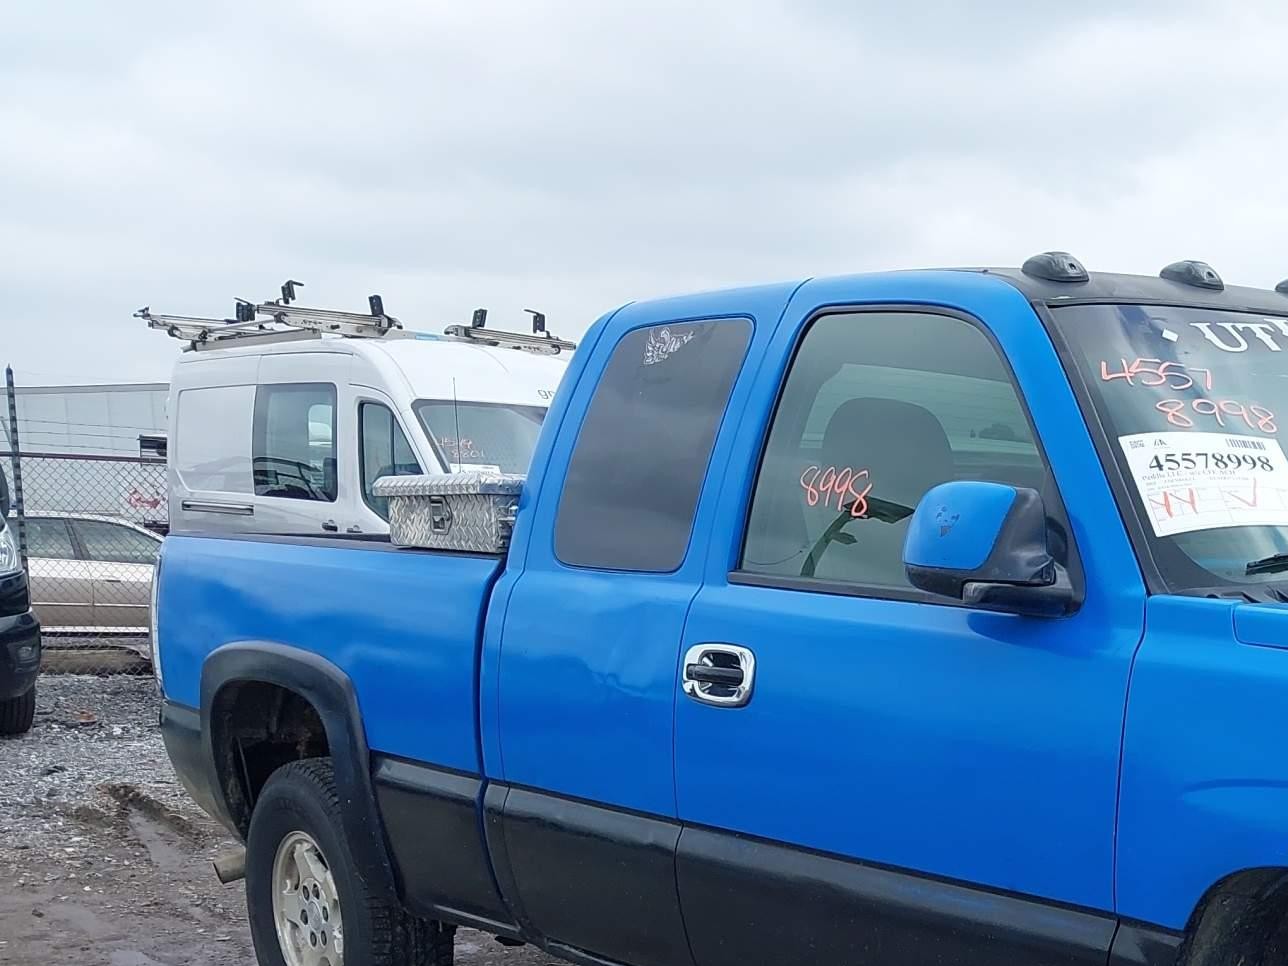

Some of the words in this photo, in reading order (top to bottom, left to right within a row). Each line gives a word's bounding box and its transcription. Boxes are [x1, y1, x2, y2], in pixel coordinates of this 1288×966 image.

[1101, 357, 1212, 391] 4557
[1155, 399, 1278, 434] 8998
[1148, 452, 1274, 473] 45578998
[800, 465, 873, 517] 8998
